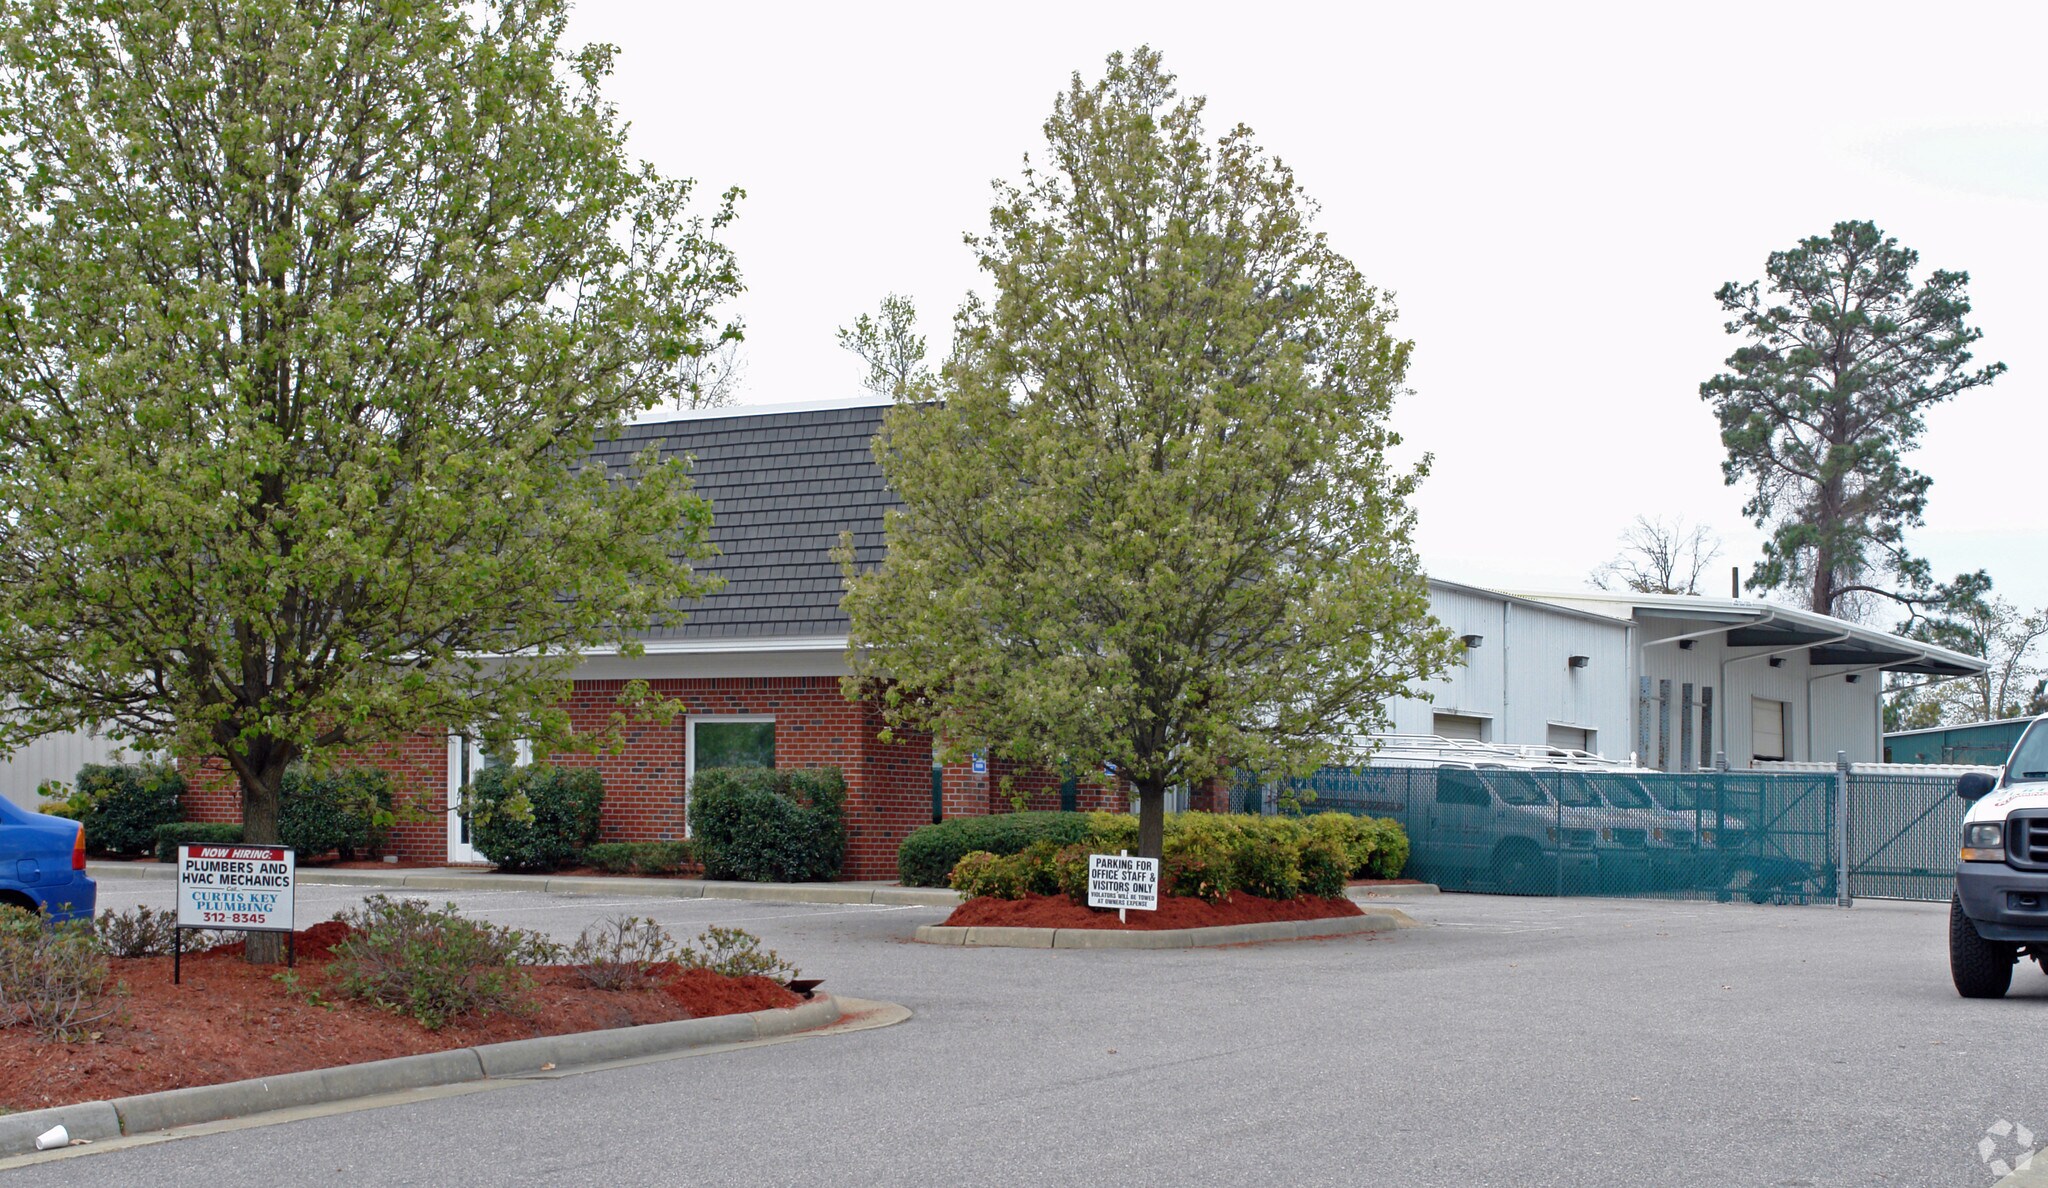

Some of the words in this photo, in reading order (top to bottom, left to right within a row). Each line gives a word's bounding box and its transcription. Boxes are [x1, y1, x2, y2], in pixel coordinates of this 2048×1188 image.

[201, 848, 229, 858] NOW
[231, 849, 273, 860] HIRING:
[186, 861, 253, 874] PLUMBERS
[259, 863, 288, 875] AND
[1096, 858, 1133, 870] PARKING
[1136, 860, 1152, 871] FOR
[182, 873, 214, 885] HVAC
[219, 874, 290, 887] MECHANICS
[1091, 869, 1118, 880] OFFICE
[1121, 871, 1147, 882] STAFF
[1149, 873, 1156, 883] &
[1093, 880, 1130, 892] VISITORS
[1133, 882, 1153, 893] ONLY
[191, 891, 244, 902] CURTIS
[250, 893, 278, 904] KEY
[197, 901, 273, 913] PLUMBING
[203, 912, 266, 924] 312-8345
